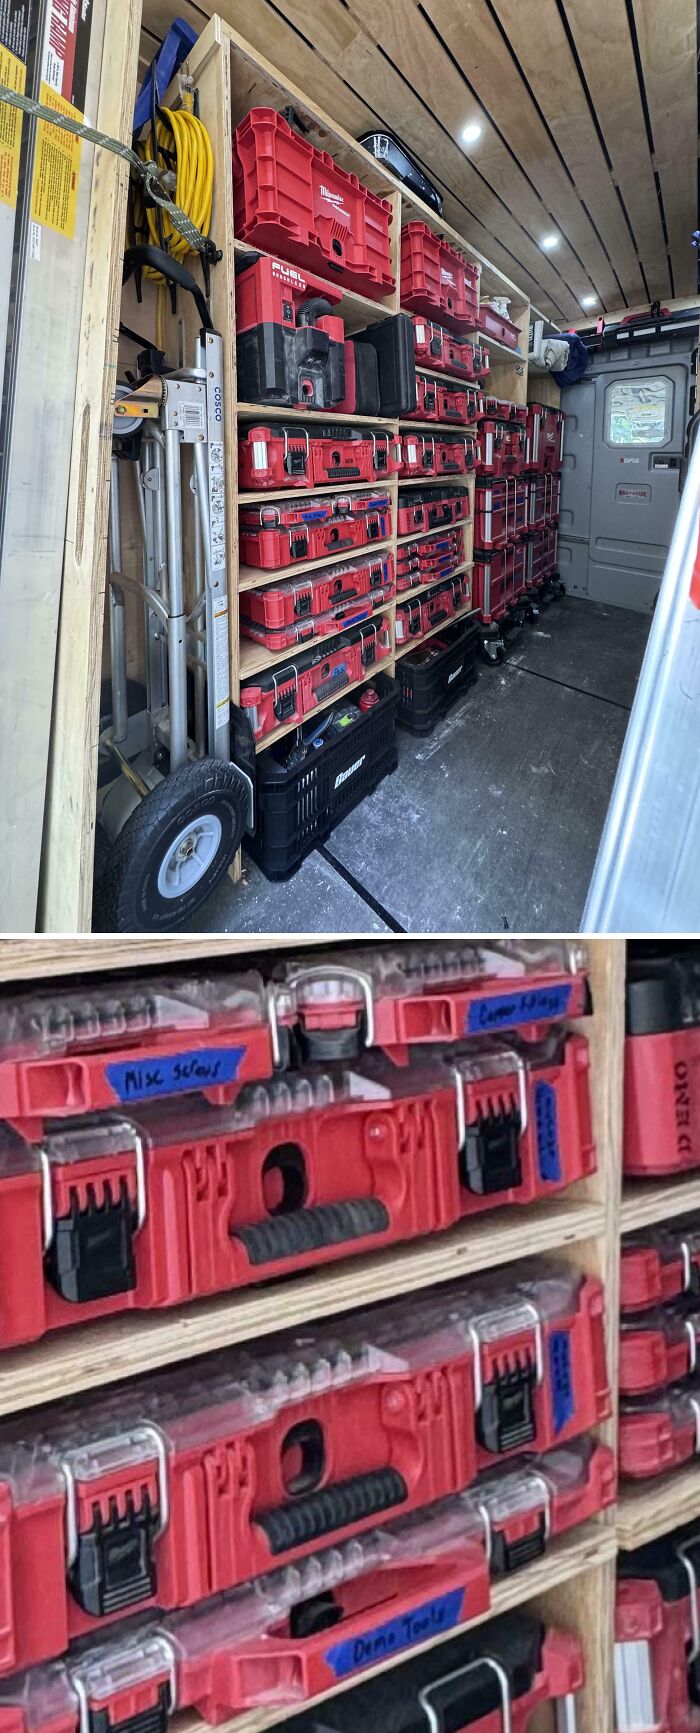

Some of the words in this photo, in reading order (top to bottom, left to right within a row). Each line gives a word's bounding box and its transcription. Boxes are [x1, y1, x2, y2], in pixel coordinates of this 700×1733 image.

[272, 261, 305, 283] FUEL
[214, 386, 222, 422] COSCO
[334, 754, 366, 790] Bauer
[673, 1060, 692, 1154] DEMO
[353, 1633, 396, 1664] Demo
[402, 1605, 446, 1639] Tools
